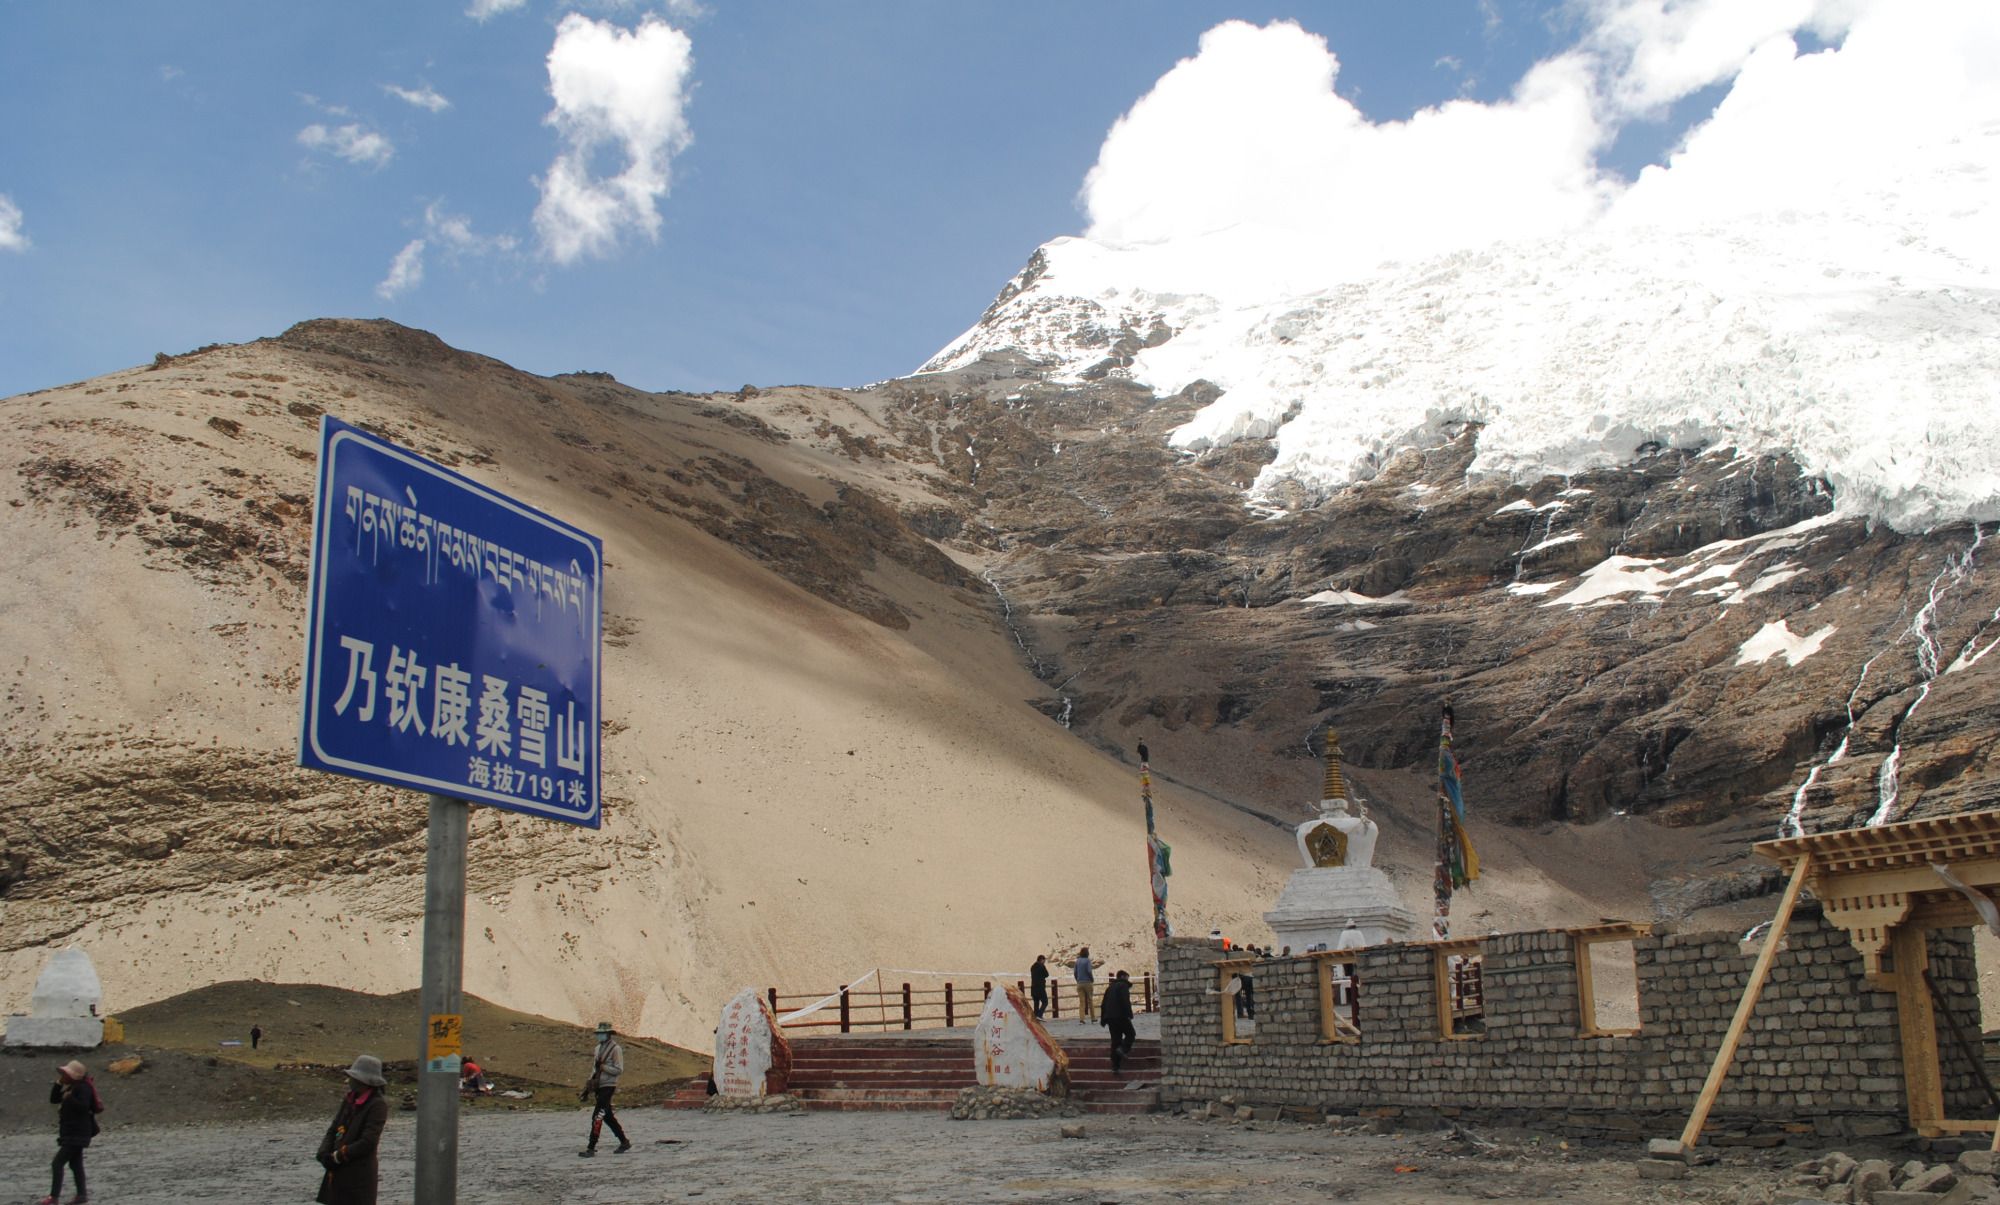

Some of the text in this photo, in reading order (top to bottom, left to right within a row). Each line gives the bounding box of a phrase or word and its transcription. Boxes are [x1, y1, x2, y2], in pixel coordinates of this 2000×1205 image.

[334, 635, 586, 776] 乃钦康桑雪山
[468, 756, 587, 807] 海拔7191米
[992, 1008, 1005, 1056] 红河谷
